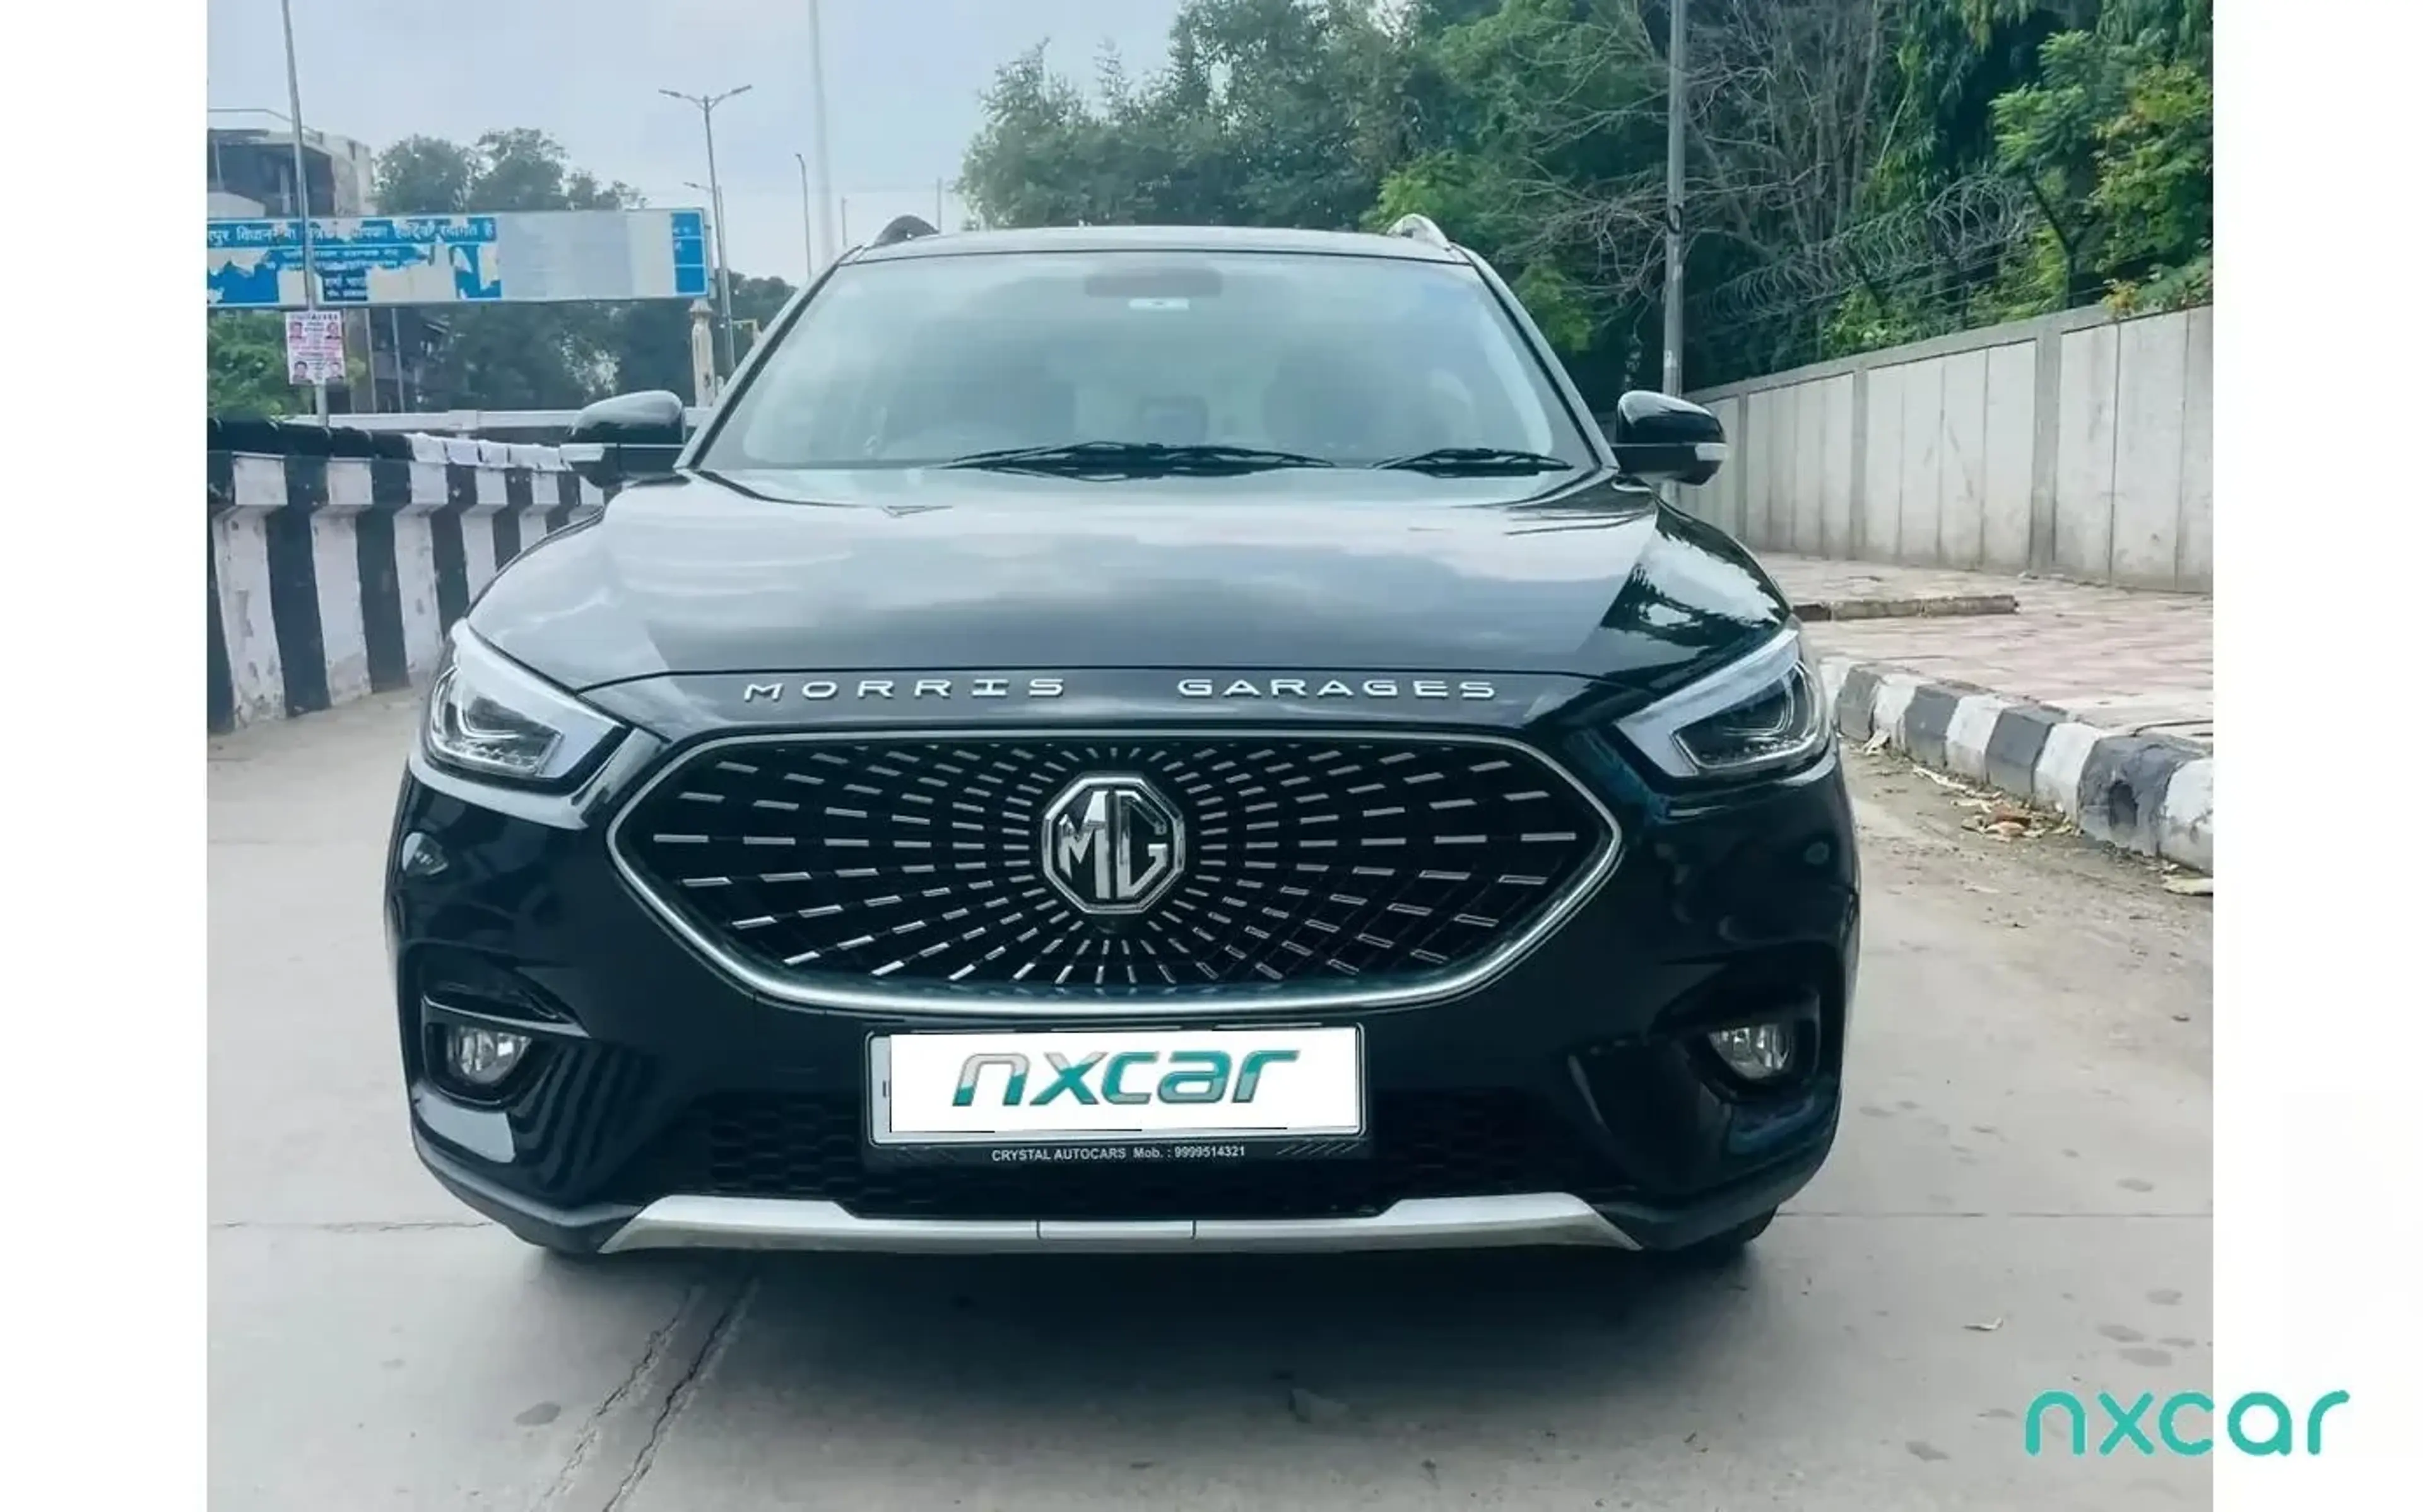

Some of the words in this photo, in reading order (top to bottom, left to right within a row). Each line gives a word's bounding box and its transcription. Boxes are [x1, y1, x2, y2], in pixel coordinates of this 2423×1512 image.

[744, 678, 1064, 701] MORRIS
[1177, 679, 1496, 698] GARAGES
[1058, 790, 1167, 899] MG
[991, 1149, 1051, 1162] CRYSTAL
[1054, 1147, 1127, 1161] AUTOCARS
[1133, 1147, 1164, 1159] Mob.
[1174, 1145, 1246, 1158] 9999514321
